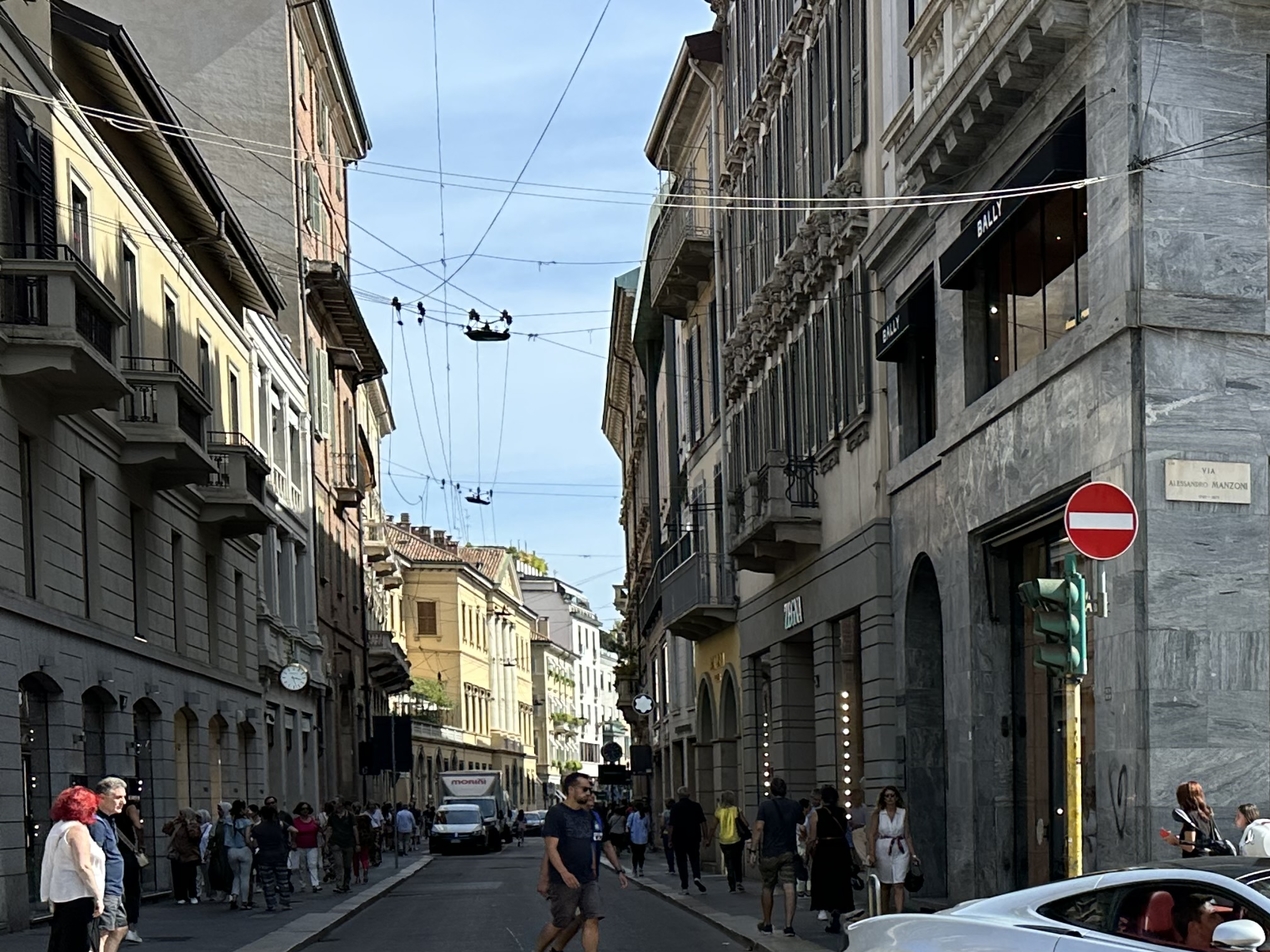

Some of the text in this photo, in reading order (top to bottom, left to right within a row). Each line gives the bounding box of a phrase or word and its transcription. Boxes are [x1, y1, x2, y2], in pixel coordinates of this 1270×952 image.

[977, 198, 1002, 238] BALLY
[883, 315, 900, 343] BALLY
[1168, 480, 1248, 490] ALESSANDRO MANZONI
